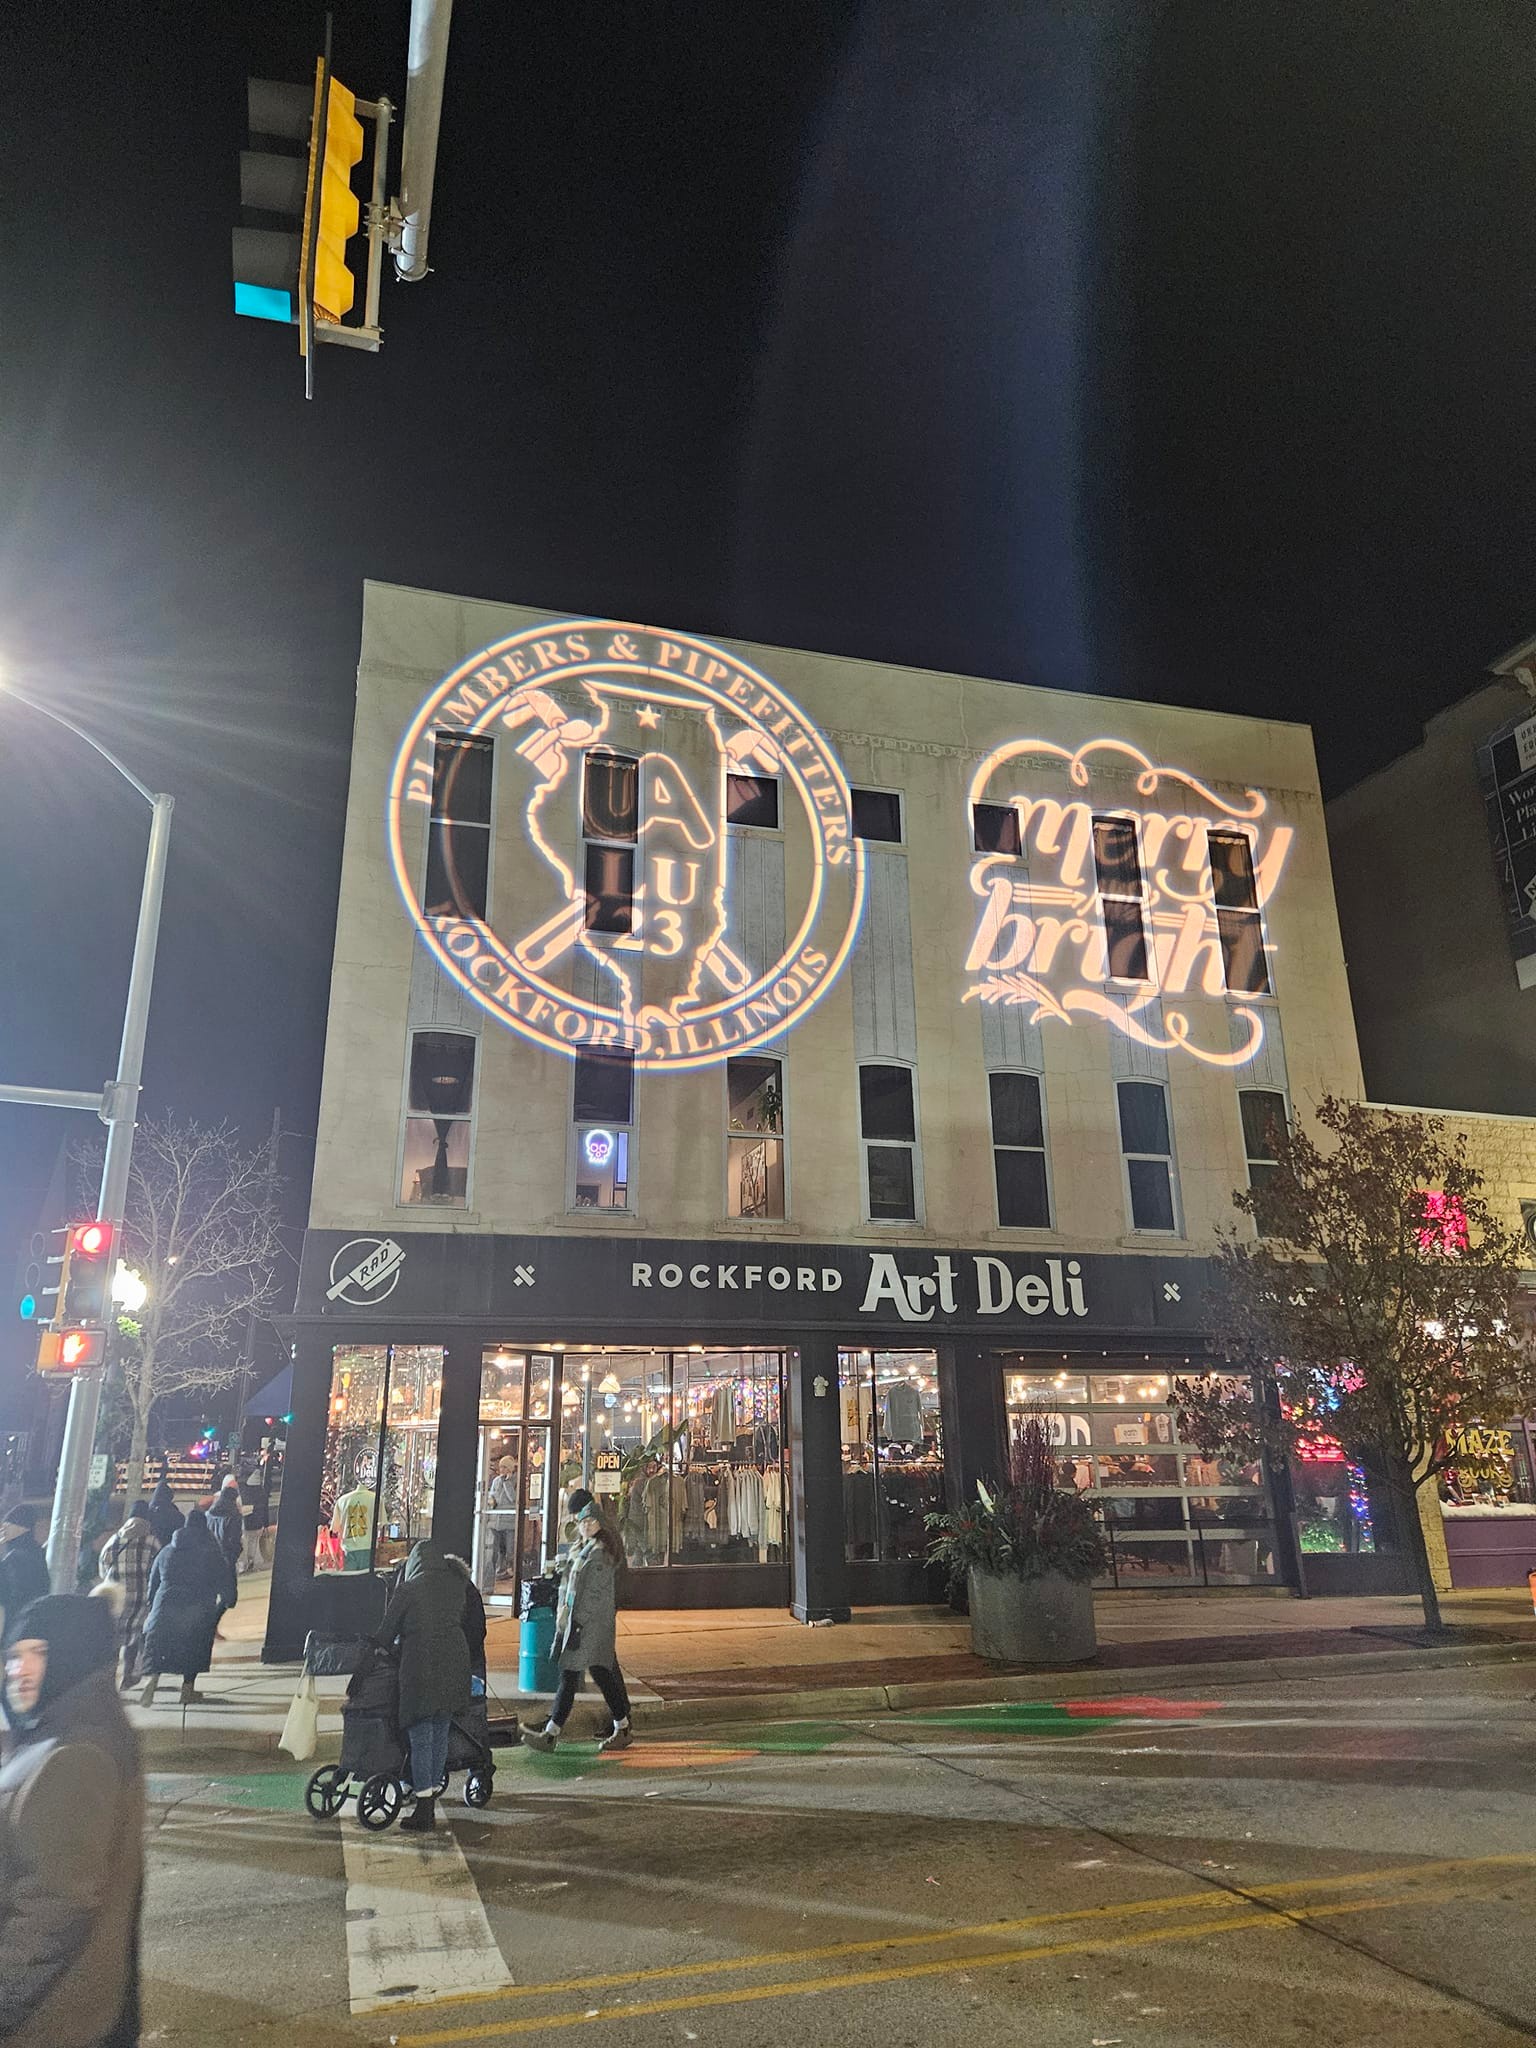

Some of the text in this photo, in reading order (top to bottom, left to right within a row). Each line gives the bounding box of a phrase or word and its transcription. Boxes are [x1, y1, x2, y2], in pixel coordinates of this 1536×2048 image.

[606, 632, 639, 661] &
[656, 641, 852, 866] PIPEFITTERS
[1008, 794, 1294, 905] merry
[359, 1248, 389, 1281] RAD
[631, 1253, 1089, 1322] ROCKFORD Art Deli
[596, 1455, 620, 1470] OPEN
[1445, 1427, 1515, 1457] MAZE
